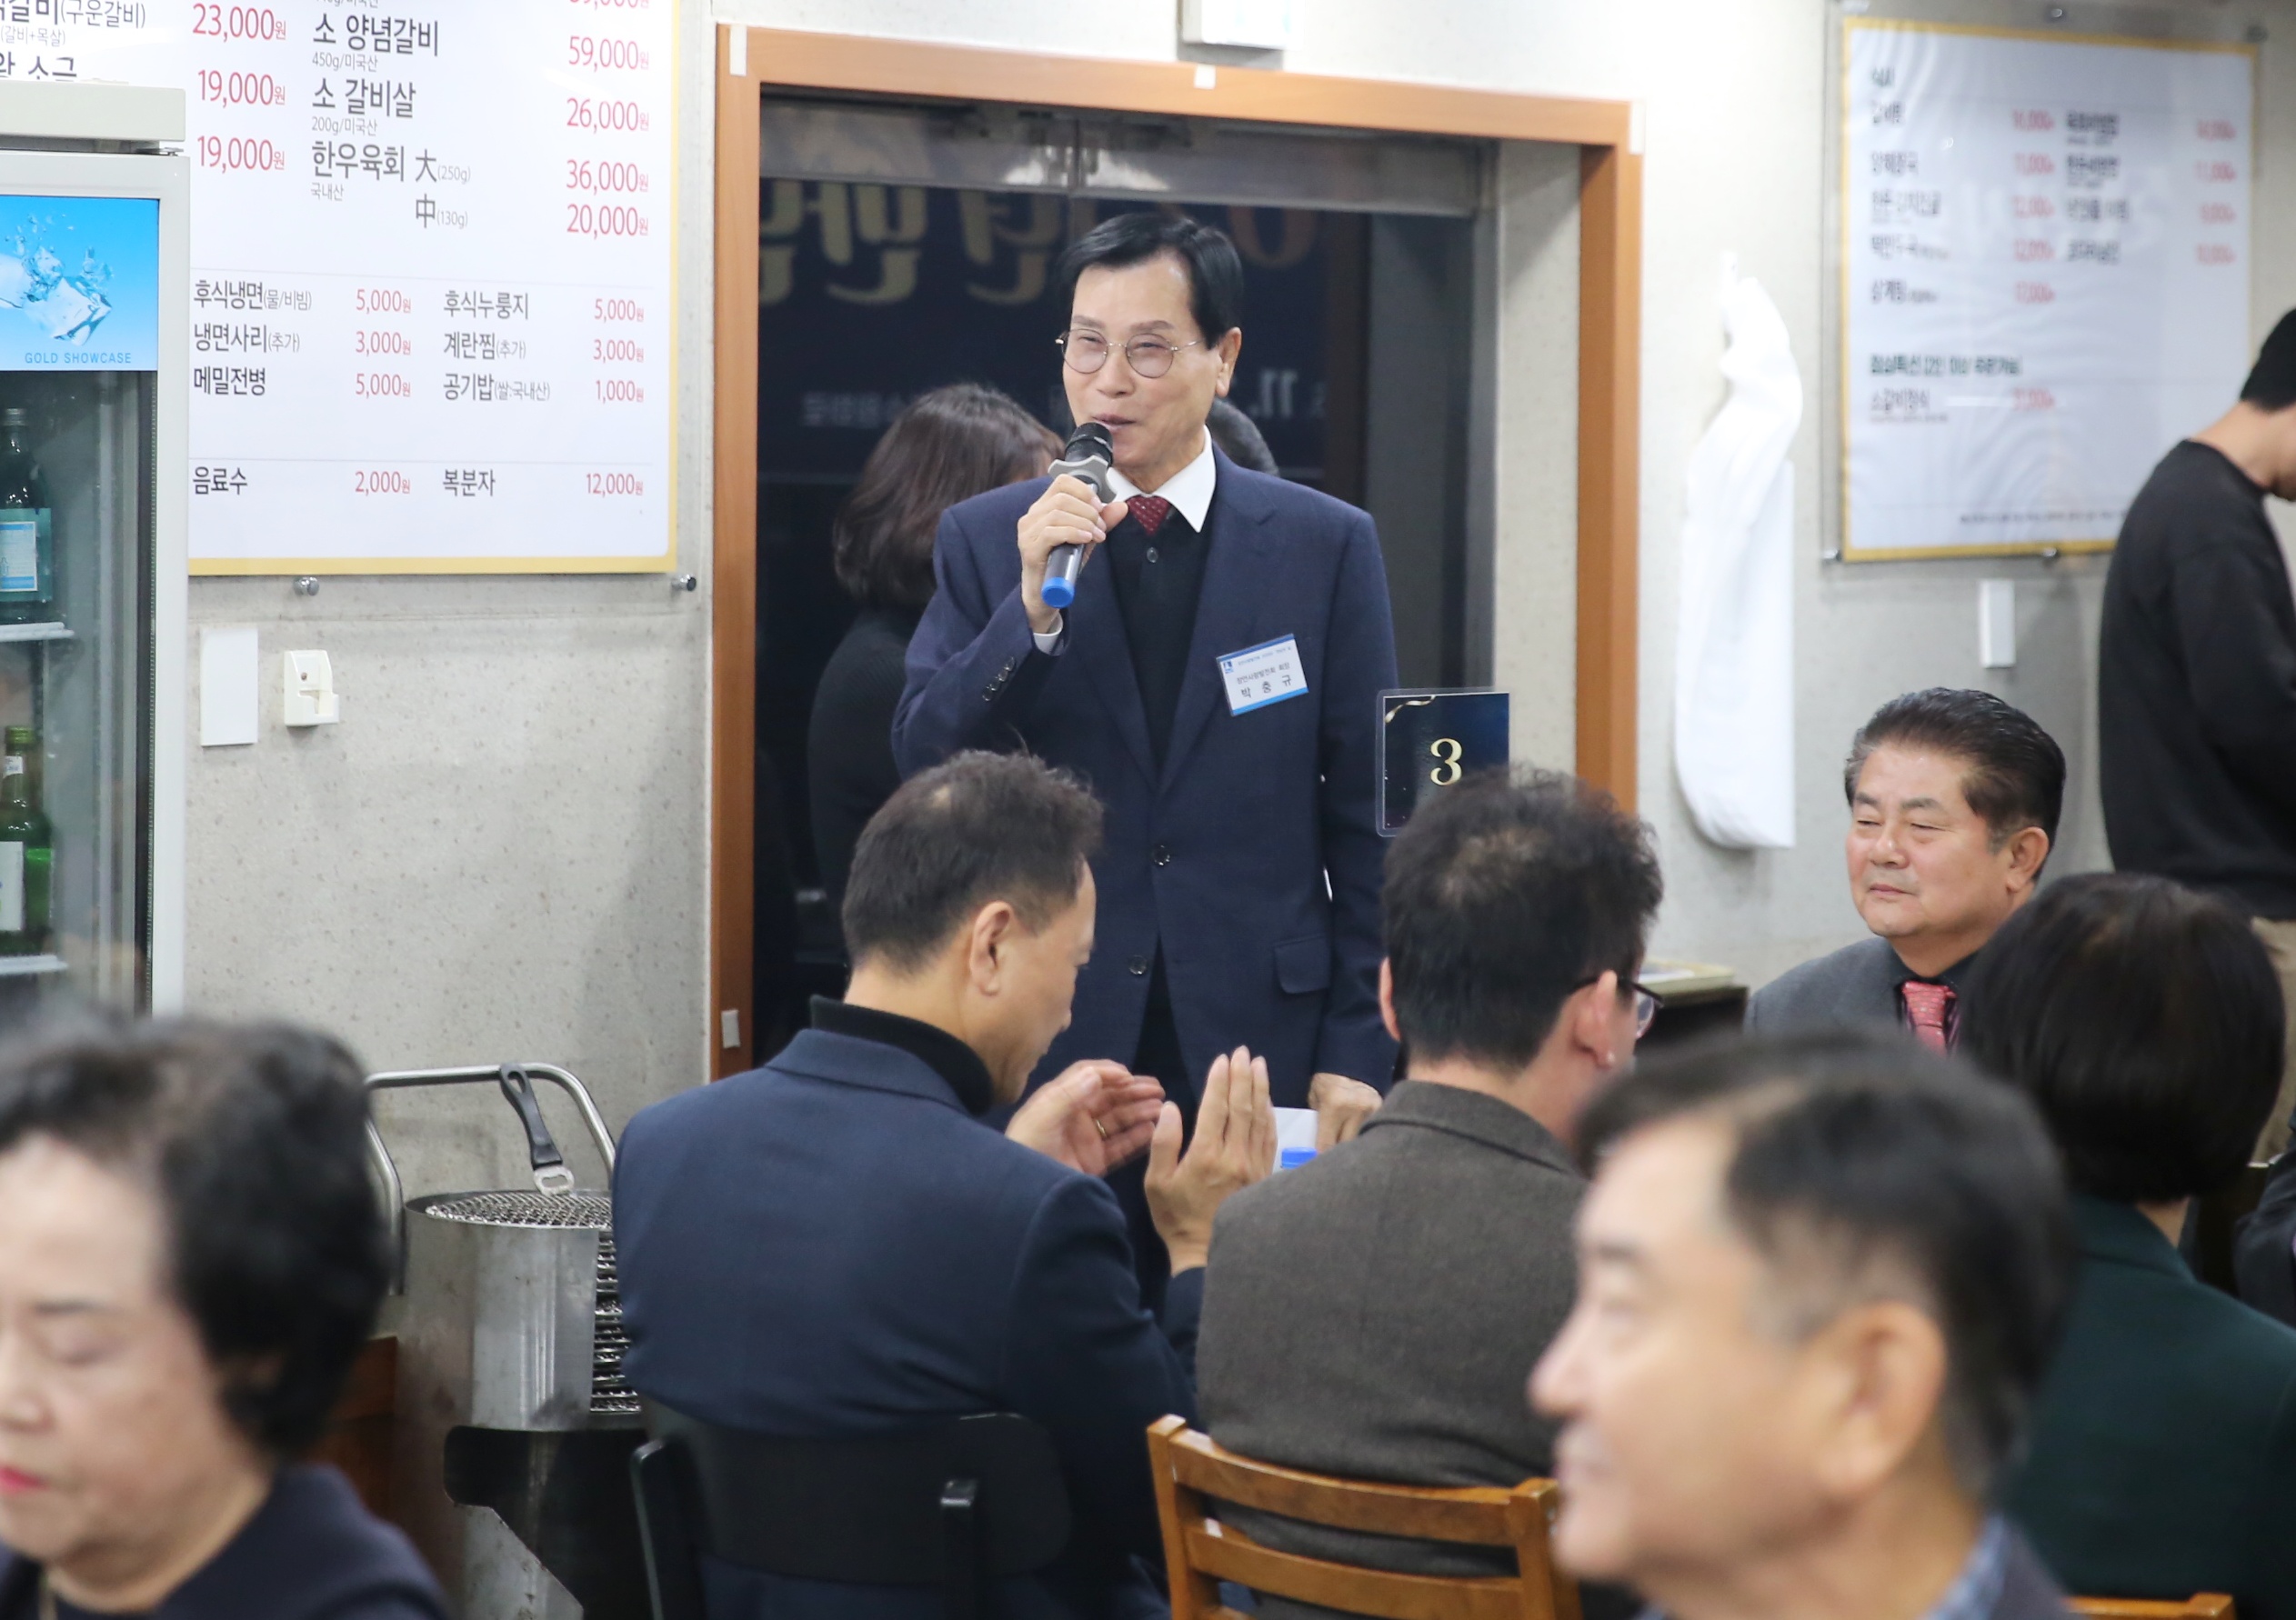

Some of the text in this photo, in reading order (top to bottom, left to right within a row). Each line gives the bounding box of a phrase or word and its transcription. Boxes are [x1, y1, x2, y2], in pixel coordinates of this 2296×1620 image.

[0, 0, 286, 42] 갈비(구운갈비) 23,000원
[1, 25, 65, 47] (갈비+목살)
[313, 13, 648, 72] 소 양념갈비 59,000원
[312, 51, 378, 73] 450g/미국산
[198, 70, 285, 108] 19,000원
[313, 78, 648, 133] 소 갈비살 26,000원
[312, 116, 377, 136] 200g/미국산
[197, 135, 284, 174] 19,000원
[312, 141, 404, 182] 한우육회
[566, 159, 647, 195] 36,000원
[311, 182, 344, 201] 국내산
[567, 204, 647, 239] 20,000원
[356, 289, 411, 314] 5,000원
[444, 290, 528, 319] 후식누룽지
[595, 298, 644, 323] 5,000원
[25, 352, 132, 364] GOLD SHOWCASE
[356, 331, 410, 356] 3,000원
[594, 339, 644, 363] 3,000원
[195, 366, 265, 395] 메밀전병
[356, 374, 410, 398] 5,000원
[596, 380, 644, 404] 1,000원
[193, 466, 643, 497] 음료수 2,000원 복분자 12,000원
[1430, 737, 1462, 785] 3
